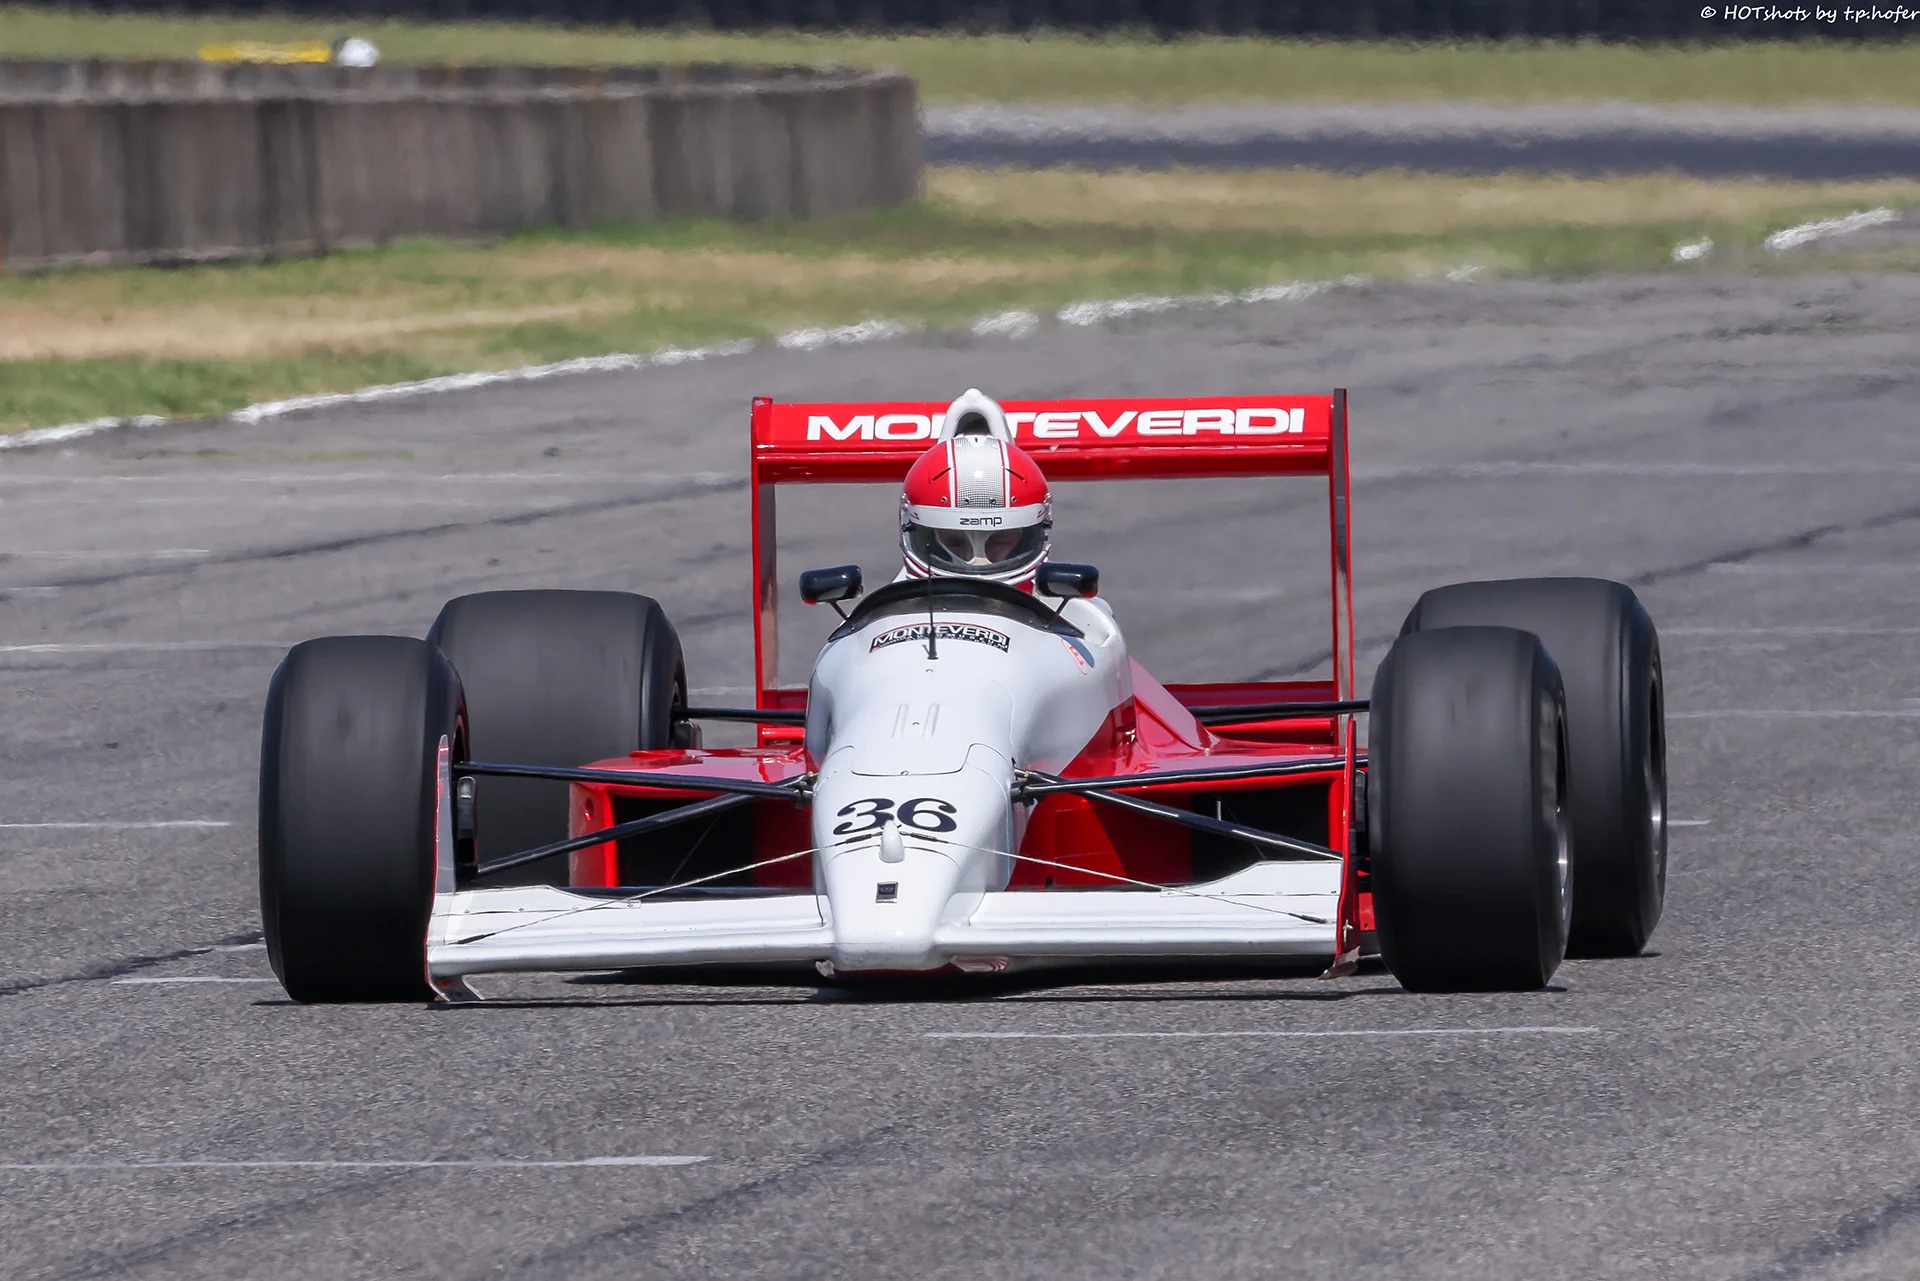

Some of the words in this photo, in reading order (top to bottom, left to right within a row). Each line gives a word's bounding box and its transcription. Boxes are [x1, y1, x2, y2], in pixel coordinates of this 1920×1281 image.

[806, 407, 1305, 440] MOTEVERDI
[959, 516, 1002, 527] zamp
[833, 797, 957, 835] 36
